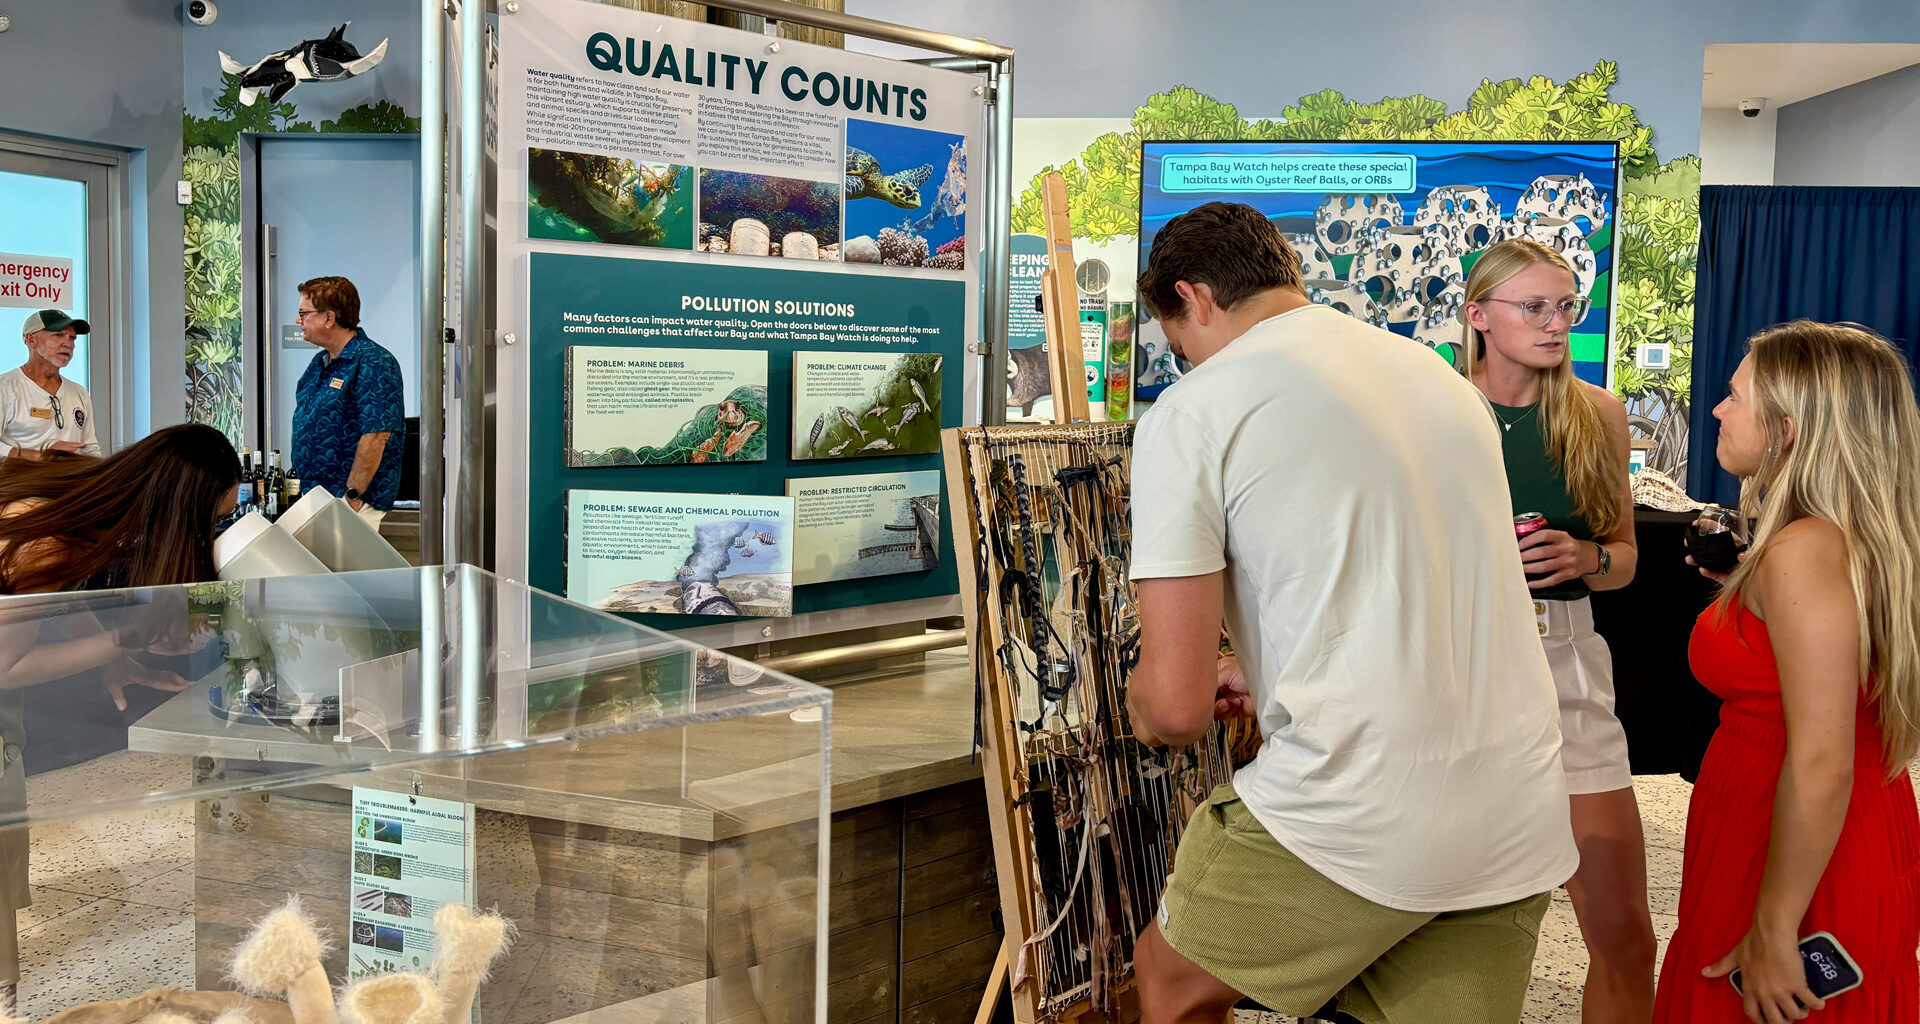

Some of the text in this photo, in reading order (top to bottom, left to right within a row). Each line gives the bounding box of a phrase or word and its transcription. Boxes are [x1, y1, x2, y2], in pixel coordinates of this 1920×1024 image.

[527, 69, 548, 77] Water
[550, 73, 574, 82] quality
[586, 32, 927, 121] QUALITY COUNTS
[527, 86, 566, 98] maintaining
[568, 91, 581, 101] high
[602, 97, 624, 105] quality
[662, 105, 692, 115] preserving
[561, 82, 586, 90] humans
[633, 92, 655, 103] Tampa
[655, 96, 668, 104] Bay,
[565, 99, 591, 110] estuary,
[612, 106, 640, 116] supports
[724, 98, 743, 107] Tampa
[745, 102, 755, 110] Bay
[815, 113, 836, 121] forefront
[527, 110, 545, 118] While
[547, 113, 581, 125] significant
[583, 117, 626, 129] improvements
[651, 119, 679, 128] economy.
[653, 135, 690, 145] development
[1170, 163, 1207, 173] Tampa
[1211, 162, 1230, 173] Bay
[1233, 162, 1268, 171] Watch
[1271, 163, 1299, 173] helps
[1339, 162, 1367, 171] these
[1370, 162, 1407, 173] special
[1184, 175, 1228, 184] habitats
[1231, 175, 1253, 184] with
[1256, 175, 1291, 186] Oyster
[1294, 175, 1317, 184] Reef
[1320, 176, 1348, 185] Balls,
[1365, 176, 1392, 184] ORBs
[1010, 254, 1049, 265] EPING
[26, 282, 61, 302] Only
[682, 296, 854, 317] POLLUTION SOLUTIONS
[564, 312, 591, 324] Many
[594, 313, 630, 323] factors
[652, 316, 684, 328] impact
[714, 319, 749, 330] quality.
[751, 320, 772, 331] Open
[607, 326, 660, 337] challenges
[684, 328, 712, 336] affect
[731, 329, 747, 340] Bay
[749, 329, 765, 338] and
[790, 332, 818, 341] Tampa
[820, 333, 834, 342] Bay
[870, 334, 890, 344] doing
[901, 335, 918, 344] help.
[1810, 952, 1838, 980] 6:48
